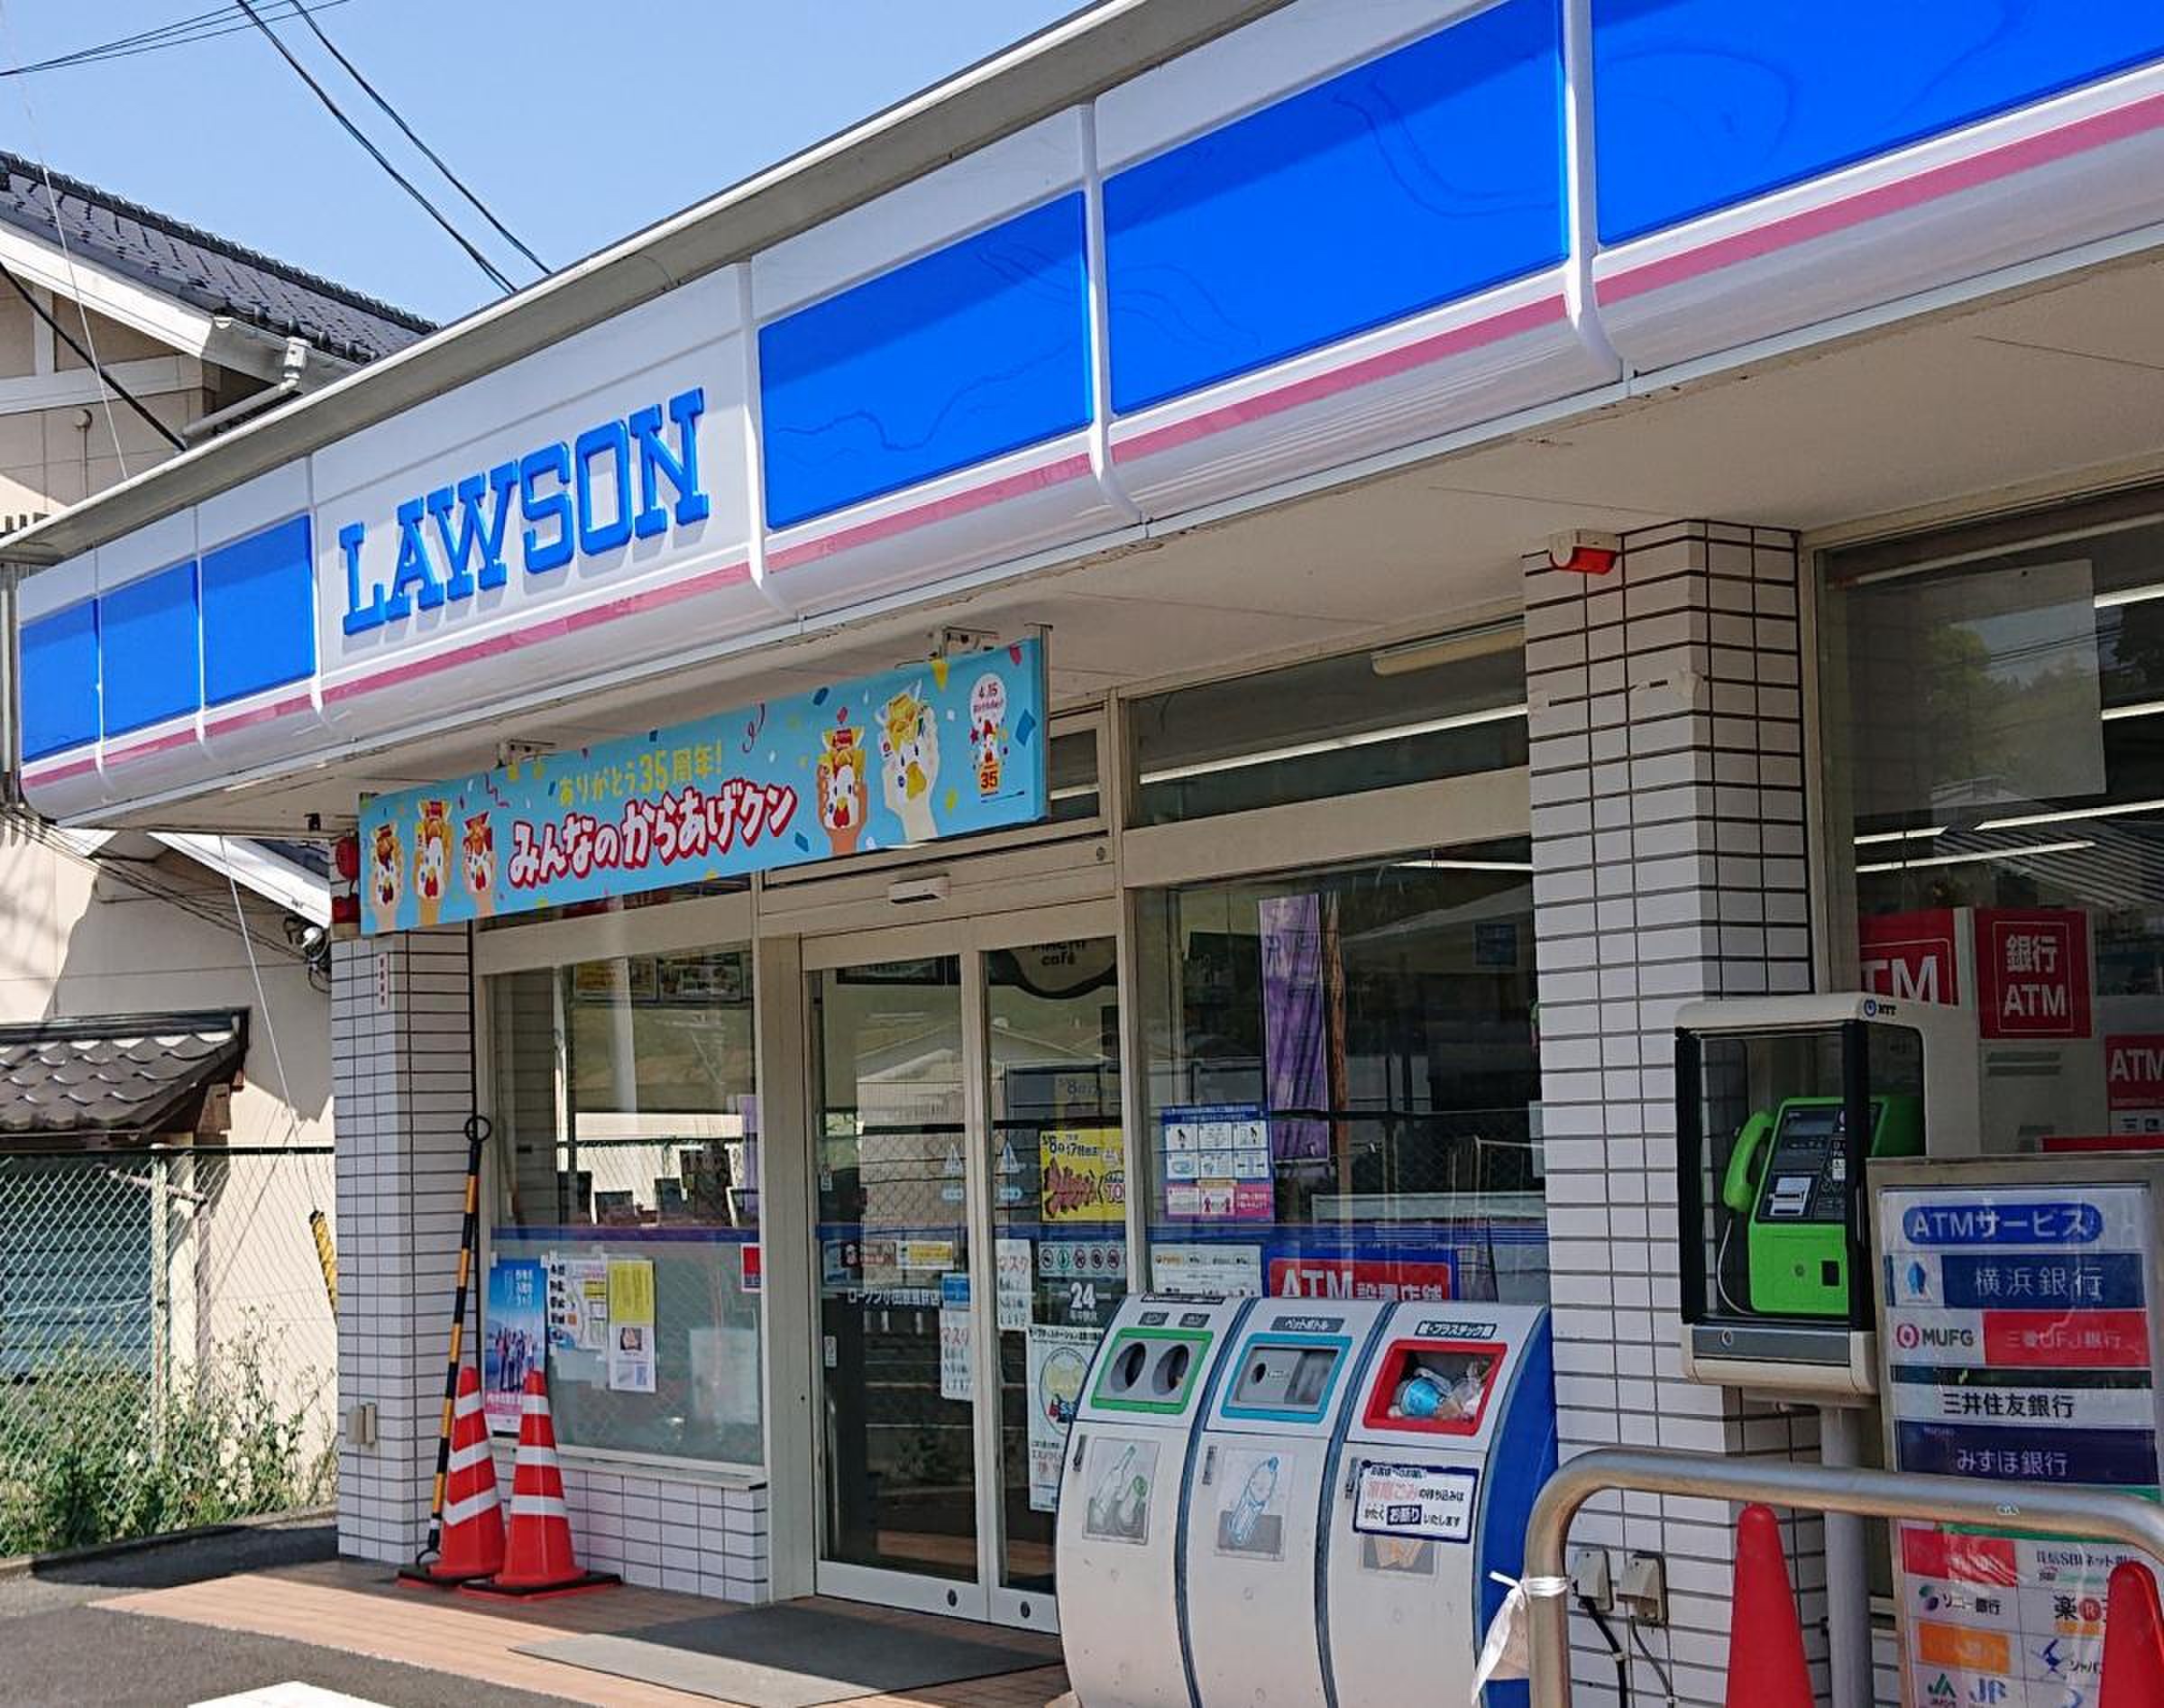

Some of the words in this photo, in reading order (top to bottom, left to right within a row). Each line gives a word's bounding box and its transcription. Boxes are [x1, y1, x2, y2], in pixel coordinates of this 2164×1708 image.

[339, 387, 710, 637] LAWSON
[981, 771, 997, 789] 35
[508, 776, 798, 888] みんなのからあげクン
[2006, 933, 2058, 973] 銀行
[1877, 1005, 1896, 1015] NTT
[2004, 984, 2066, 1017] ATM
[1912, 1208, 2090, 1239] ATMサービス
[1070, 1282, 1096, 1309] 24
[1975, 1266, 2105, 1299] 横浜銀行
[1284, 1319, 1329, 1331] ペットボトル
[1921, 1329, 1975, 1347] MUFG
[1942, 1393, 2075, 1419] 三井住友銀行
[1957, 1446, 2068, 1477] みずほ銀行
